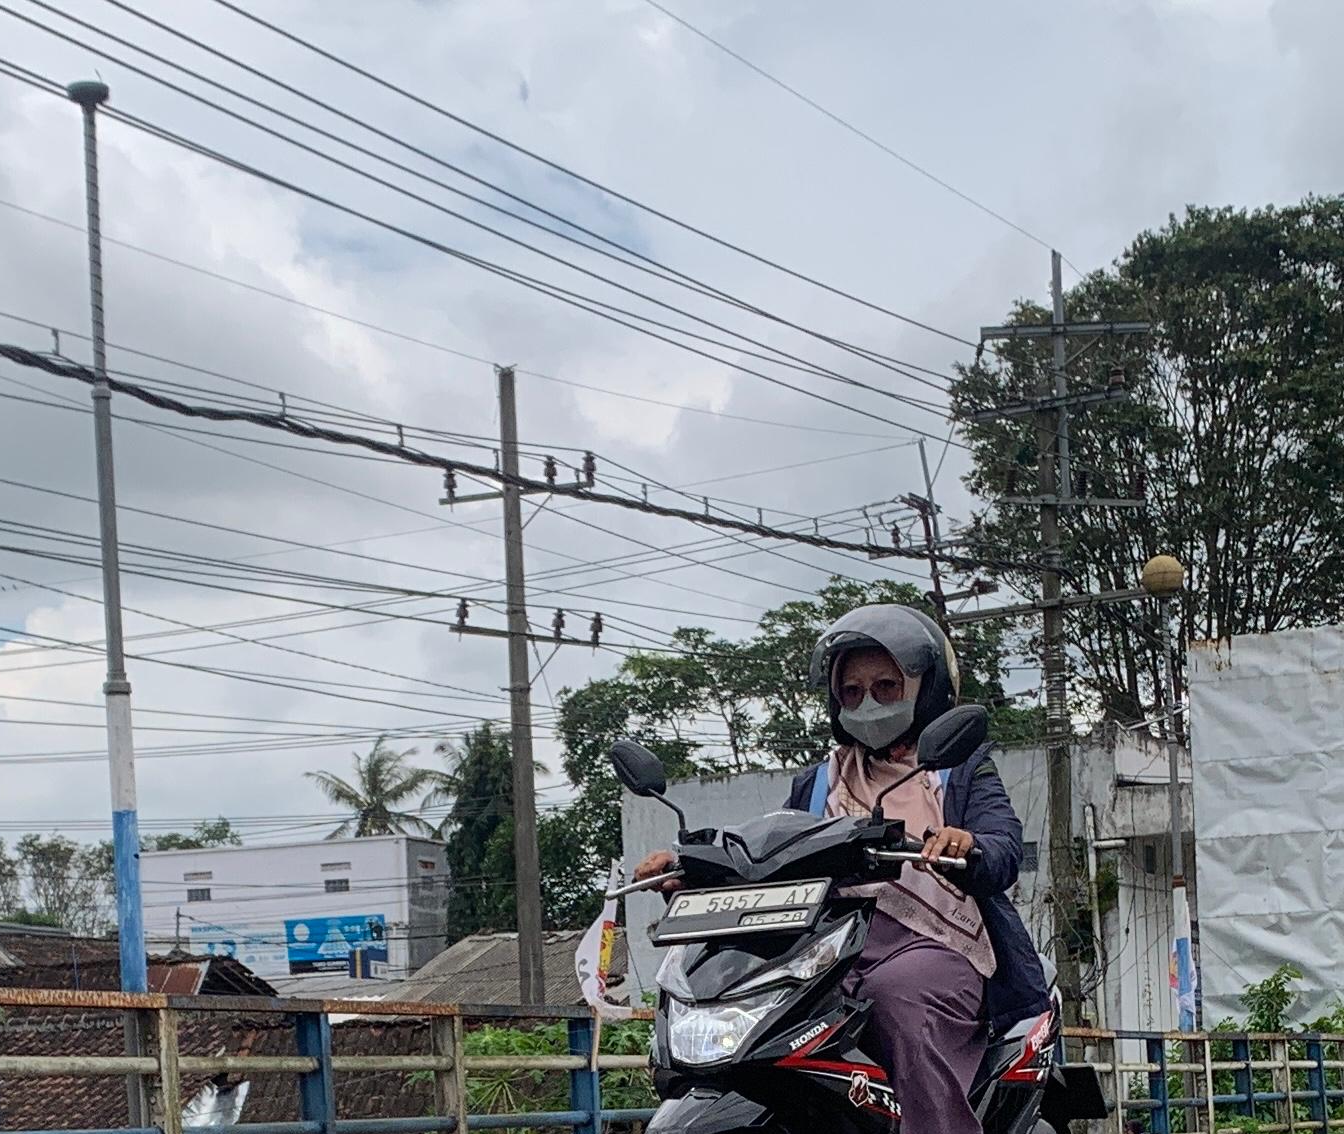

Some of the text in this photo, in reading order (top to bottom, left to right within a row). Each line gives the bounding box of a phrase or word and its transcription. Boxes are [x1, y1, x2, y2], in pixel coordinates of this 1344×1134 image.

[674, 887, 816, 916] P 5957 AY
[789, 1021, 830, 1051] HONDA
